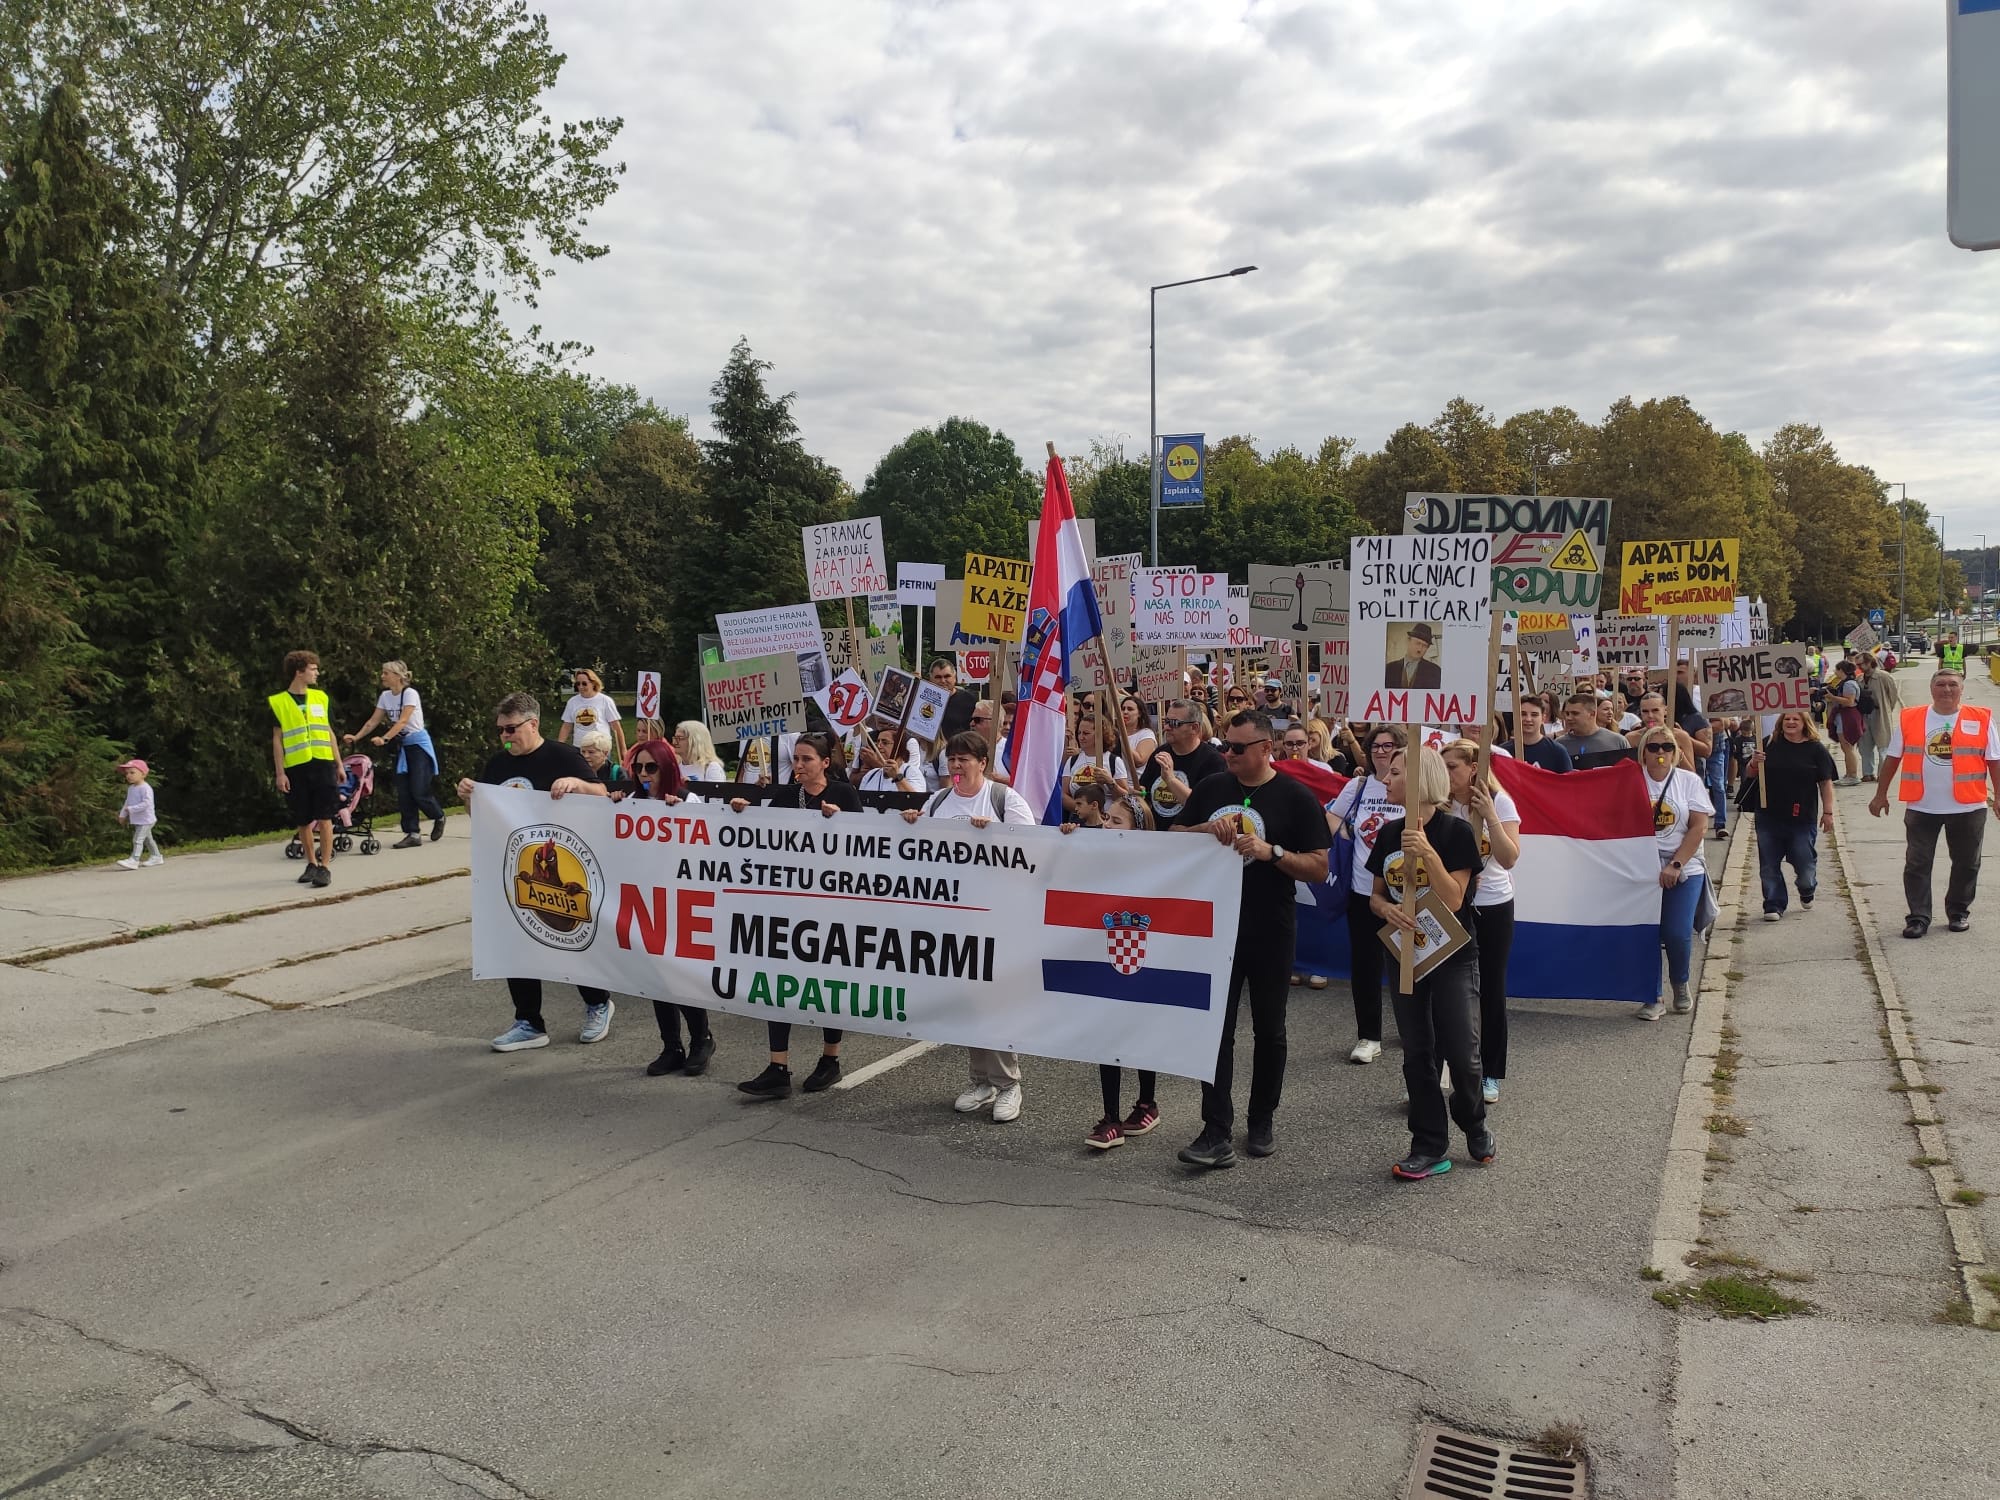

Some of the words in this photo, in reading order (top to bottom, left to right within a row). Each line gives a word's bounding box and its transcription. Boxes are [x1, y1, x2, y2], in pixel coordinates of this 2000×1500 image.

[1164, 486, 1190, 496] Isplati
[813, 522, 873, 545] STRANAC
[1412, 538, 1489, 563] NISMO
[1628, 540, 1725, 565] APATIJA
[813, 556, 875, 581] APATIJA
[1362, 562, 1476, 588] STRUČNJACI
[1638, 570, 1655, 585] je
[1657, 567, 1680, 583] naš
[812, 580, 845, 597] GUTA
[851, 574, 888, 593] SMRAD
[1152, 574, 1215, 597] STOP
[1383, 588, 1396, 597] MI
[1409, 588, 1438, 597] SMO
[969, 585, 1028, 612] KAŽE
[1180, 598, 1222, 610] PRIRODA
[1255, 596, 1289, 609] PROFIT
[1621, 583, 1653, 614] NE
[769, 613, 777, 621] JE
[780, 610, 808, 620] HRANA
[986, 612, 1016, 634] NE
[1184, 610, 1211, 625] DOM
[727, 638, 739, 646] BEZ
[740, 634, 773, 645] UBIJANJA
[773, 630, 815, 642] ŽIVOTINJA
[734, 625, 773, 636] OSNOVNIH
[774, 620, 814, 631] SIROVINA
[1136, 632, 1144, 640] NE
[731, 645, 777, 656] UNIŠTAVANJA
[1094, 666, 1132, 687] BIGA
[1703, 652, 1772, 684] FARME
[707, 673, 766, 697] KUPUJETE
[1751, 679, 1810, 712] BOLE
[709, 690, 765, 712] TRUJETE
[1363, 690, 1409, 723] AM
[1424, 692, 1476, 723] NAJ
[712, 707, 756, 728] PRLJAVI
[760, 700, 802, 720] PROFIT
[735, 718, 788, 739] SNUJETE
[510, 834, 525, 856] STOP
[530, 830, 562, 841] FARMI
[565, 835, 592, 867] PILIĆA
[615, 813, 711, 846] DOSTA
[718, 825, 817, 853] ODLUKA
[823, 833, 838, 855] U
[845, 834, 891, 859] IME
[898, 838, 1037, 874] GRAĐANA,
[676, 858, 692, 880] A
[699, 860, 733, 883] NA
[740, 858, 815, 890] ŠTETU
[819, 870, 960, 903] GRAĐANA!
[528, 885, 578, 913] Apatija
[525, 915, 543, 934] SELO
[615, 883, 716, 962] NE
[729, 912, 995, 982] MEGAFARMI
[711, 967, 738, 999] U
[747, 971, 907, 1023] APATIJI!
